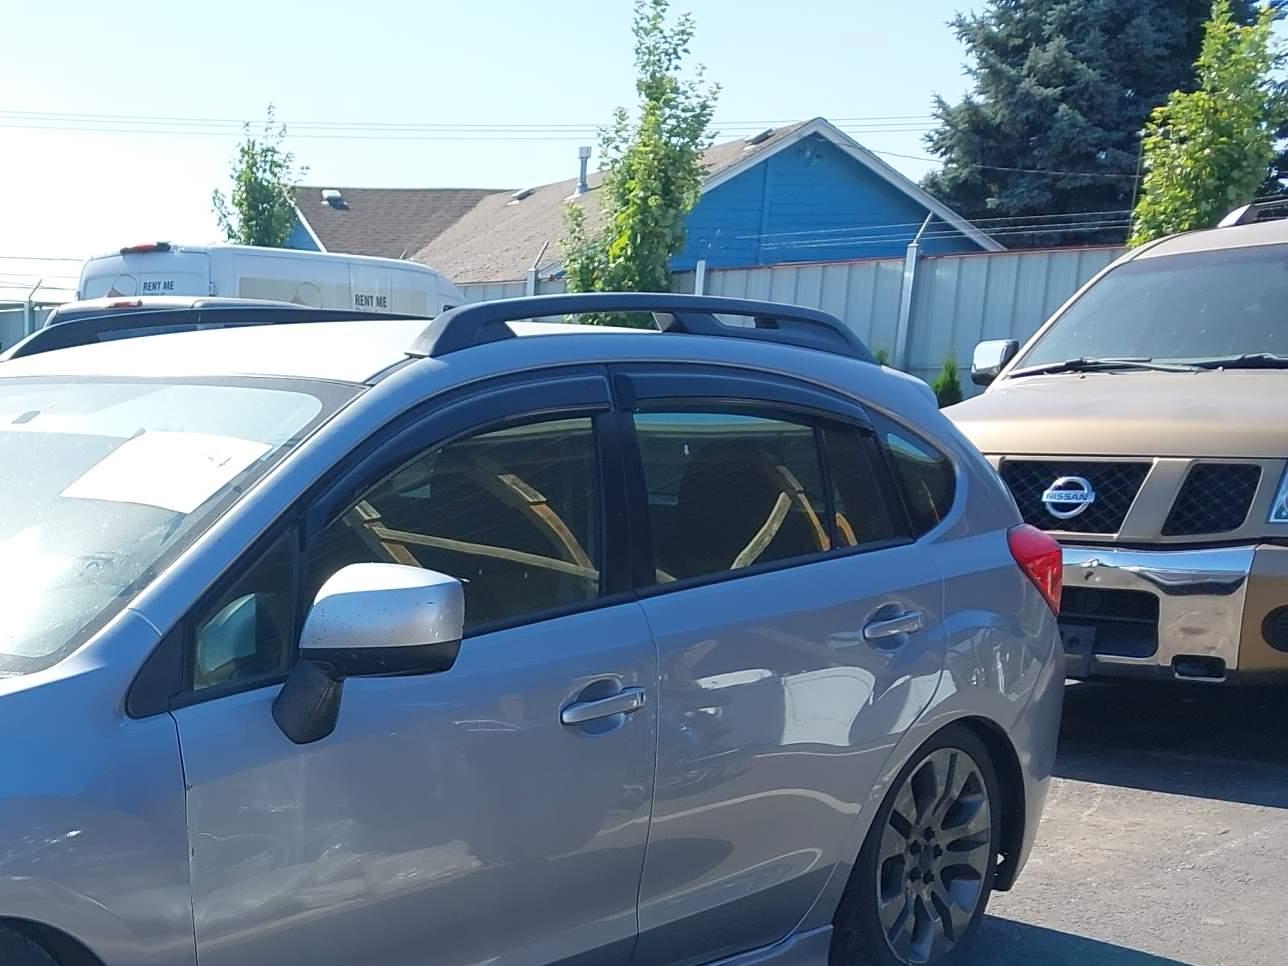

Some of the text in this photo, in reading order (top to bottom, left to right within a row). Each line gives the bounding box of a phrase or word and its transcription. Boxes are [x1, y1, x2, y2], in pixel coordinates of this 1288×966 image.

[143, 280, 175, 291] RENT ME
[355, 294, 387, 308] RENT ME
[1046, 492, 1088, 501] NISSAN
